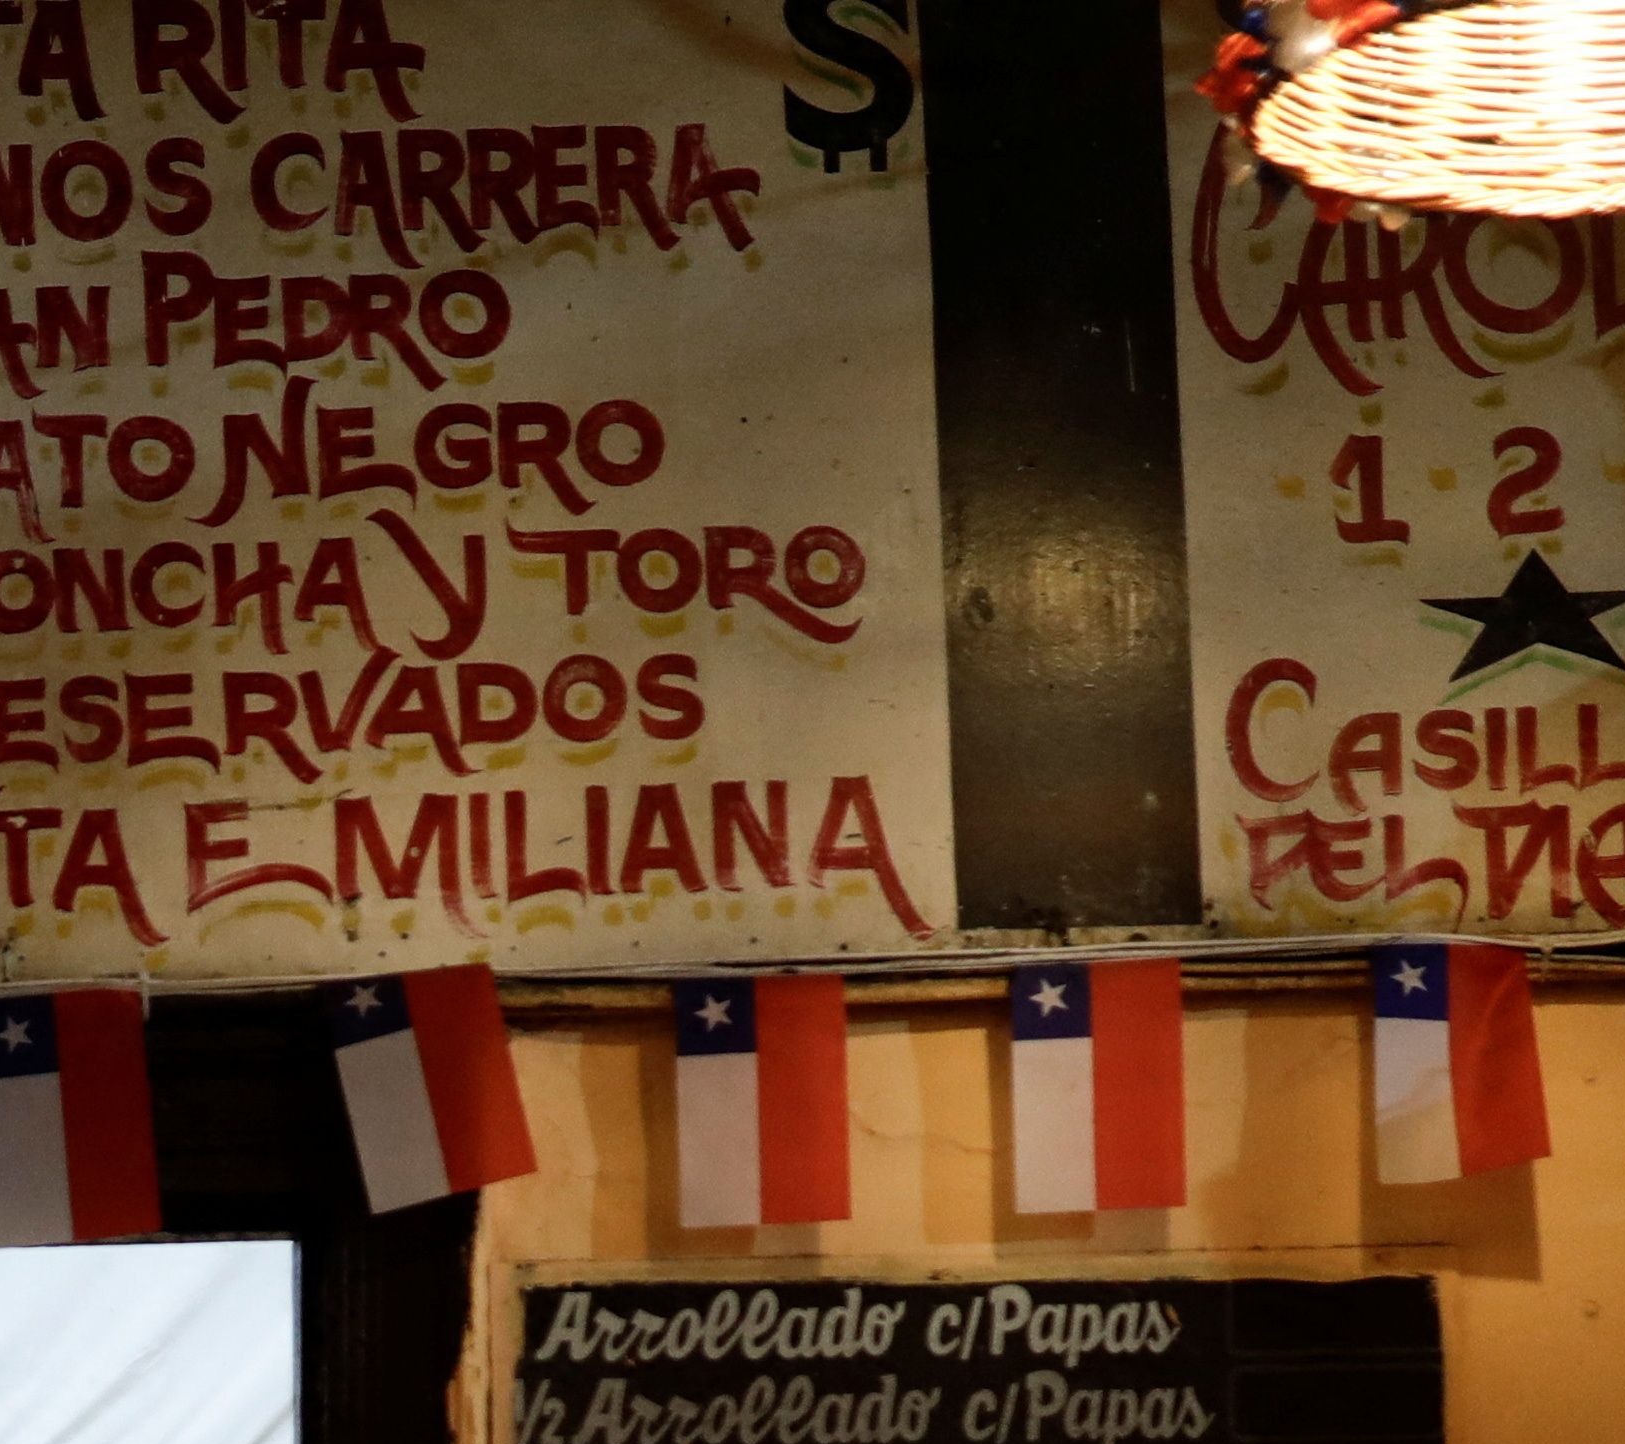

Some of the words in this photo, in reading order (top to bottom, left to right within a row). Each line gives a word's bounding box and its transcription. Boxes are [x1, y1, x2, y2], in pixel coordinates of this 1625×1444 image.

[135, 0, 425, 125] RITA
[253, 123, 760, 270] CARRERA
[142, 250, 511, 391] PEDRO
[190, 375, 665, 526] NEGRO
[1330, 434, 1410, 545] 1
[1486, 426, 1565, 540] 2
[366, 508, 486, 660] Y
[507, 516, 866, 644] TORO
[187, 774, 936, 943] EMILIANA
[536, 1287, 907, 1364] Arrollado
[925, 1283, 1184, 1366] c/Papas
